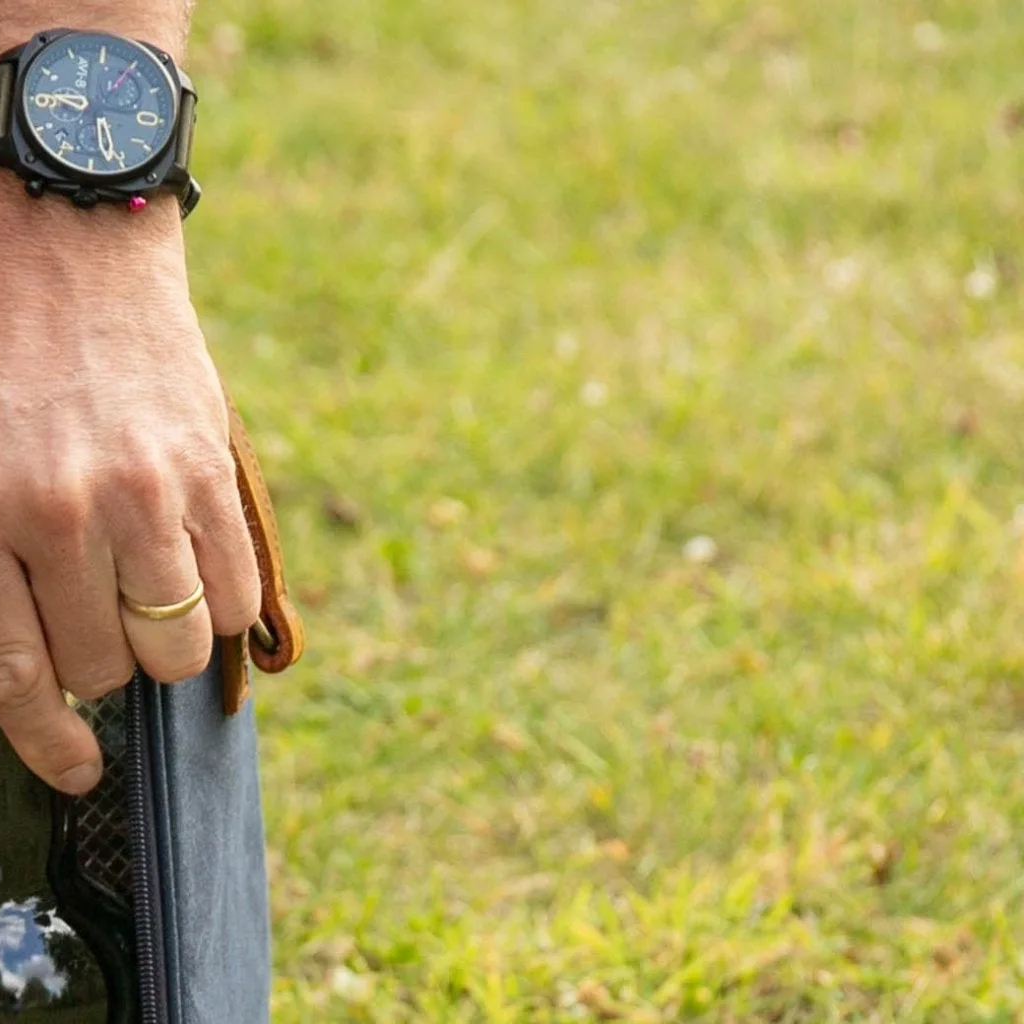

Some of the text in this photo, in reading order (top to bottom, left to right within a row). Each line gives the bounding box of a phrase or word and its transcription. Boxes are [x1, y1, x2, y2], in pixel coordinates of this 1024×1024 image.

[74, 56, 89, 88] AVI-8
[35, 93, 57, 107] 6
[59, 141, 74, 150] 4
